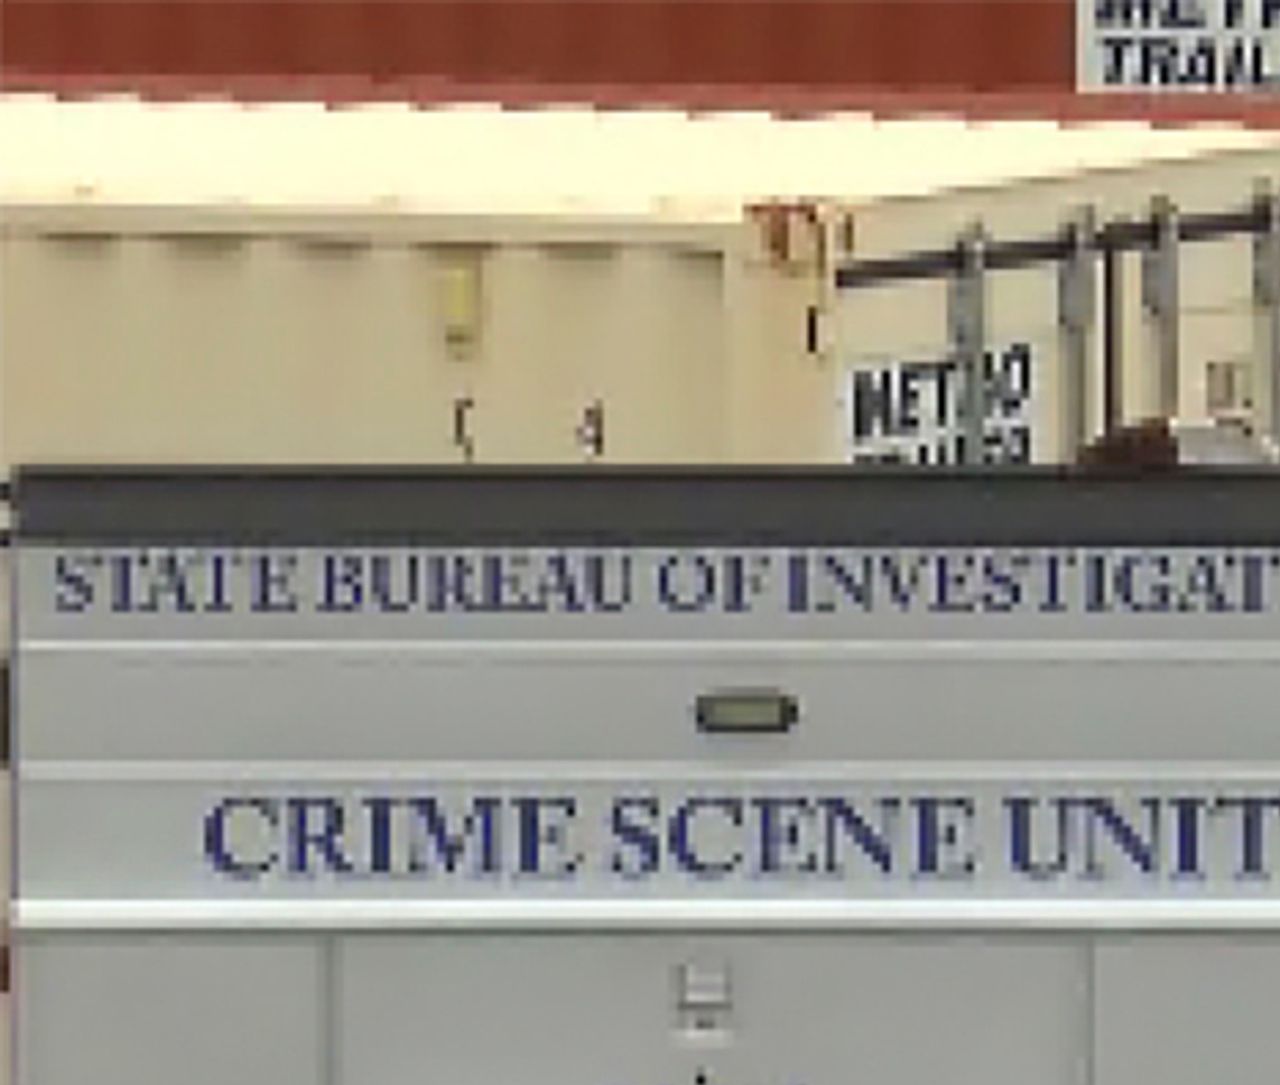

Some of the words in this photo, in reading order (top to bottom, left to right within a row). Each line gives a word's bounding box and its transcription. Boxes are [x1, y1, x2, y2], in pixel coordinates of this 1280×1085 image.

[54, 554, 298, 613] STATE
[316, 554, 633, 613] BUREAU
[658, 554, 771, 613] OF
[202, 796, 582, 881] CRIME
[610, 796, 977, 881] SCENE
